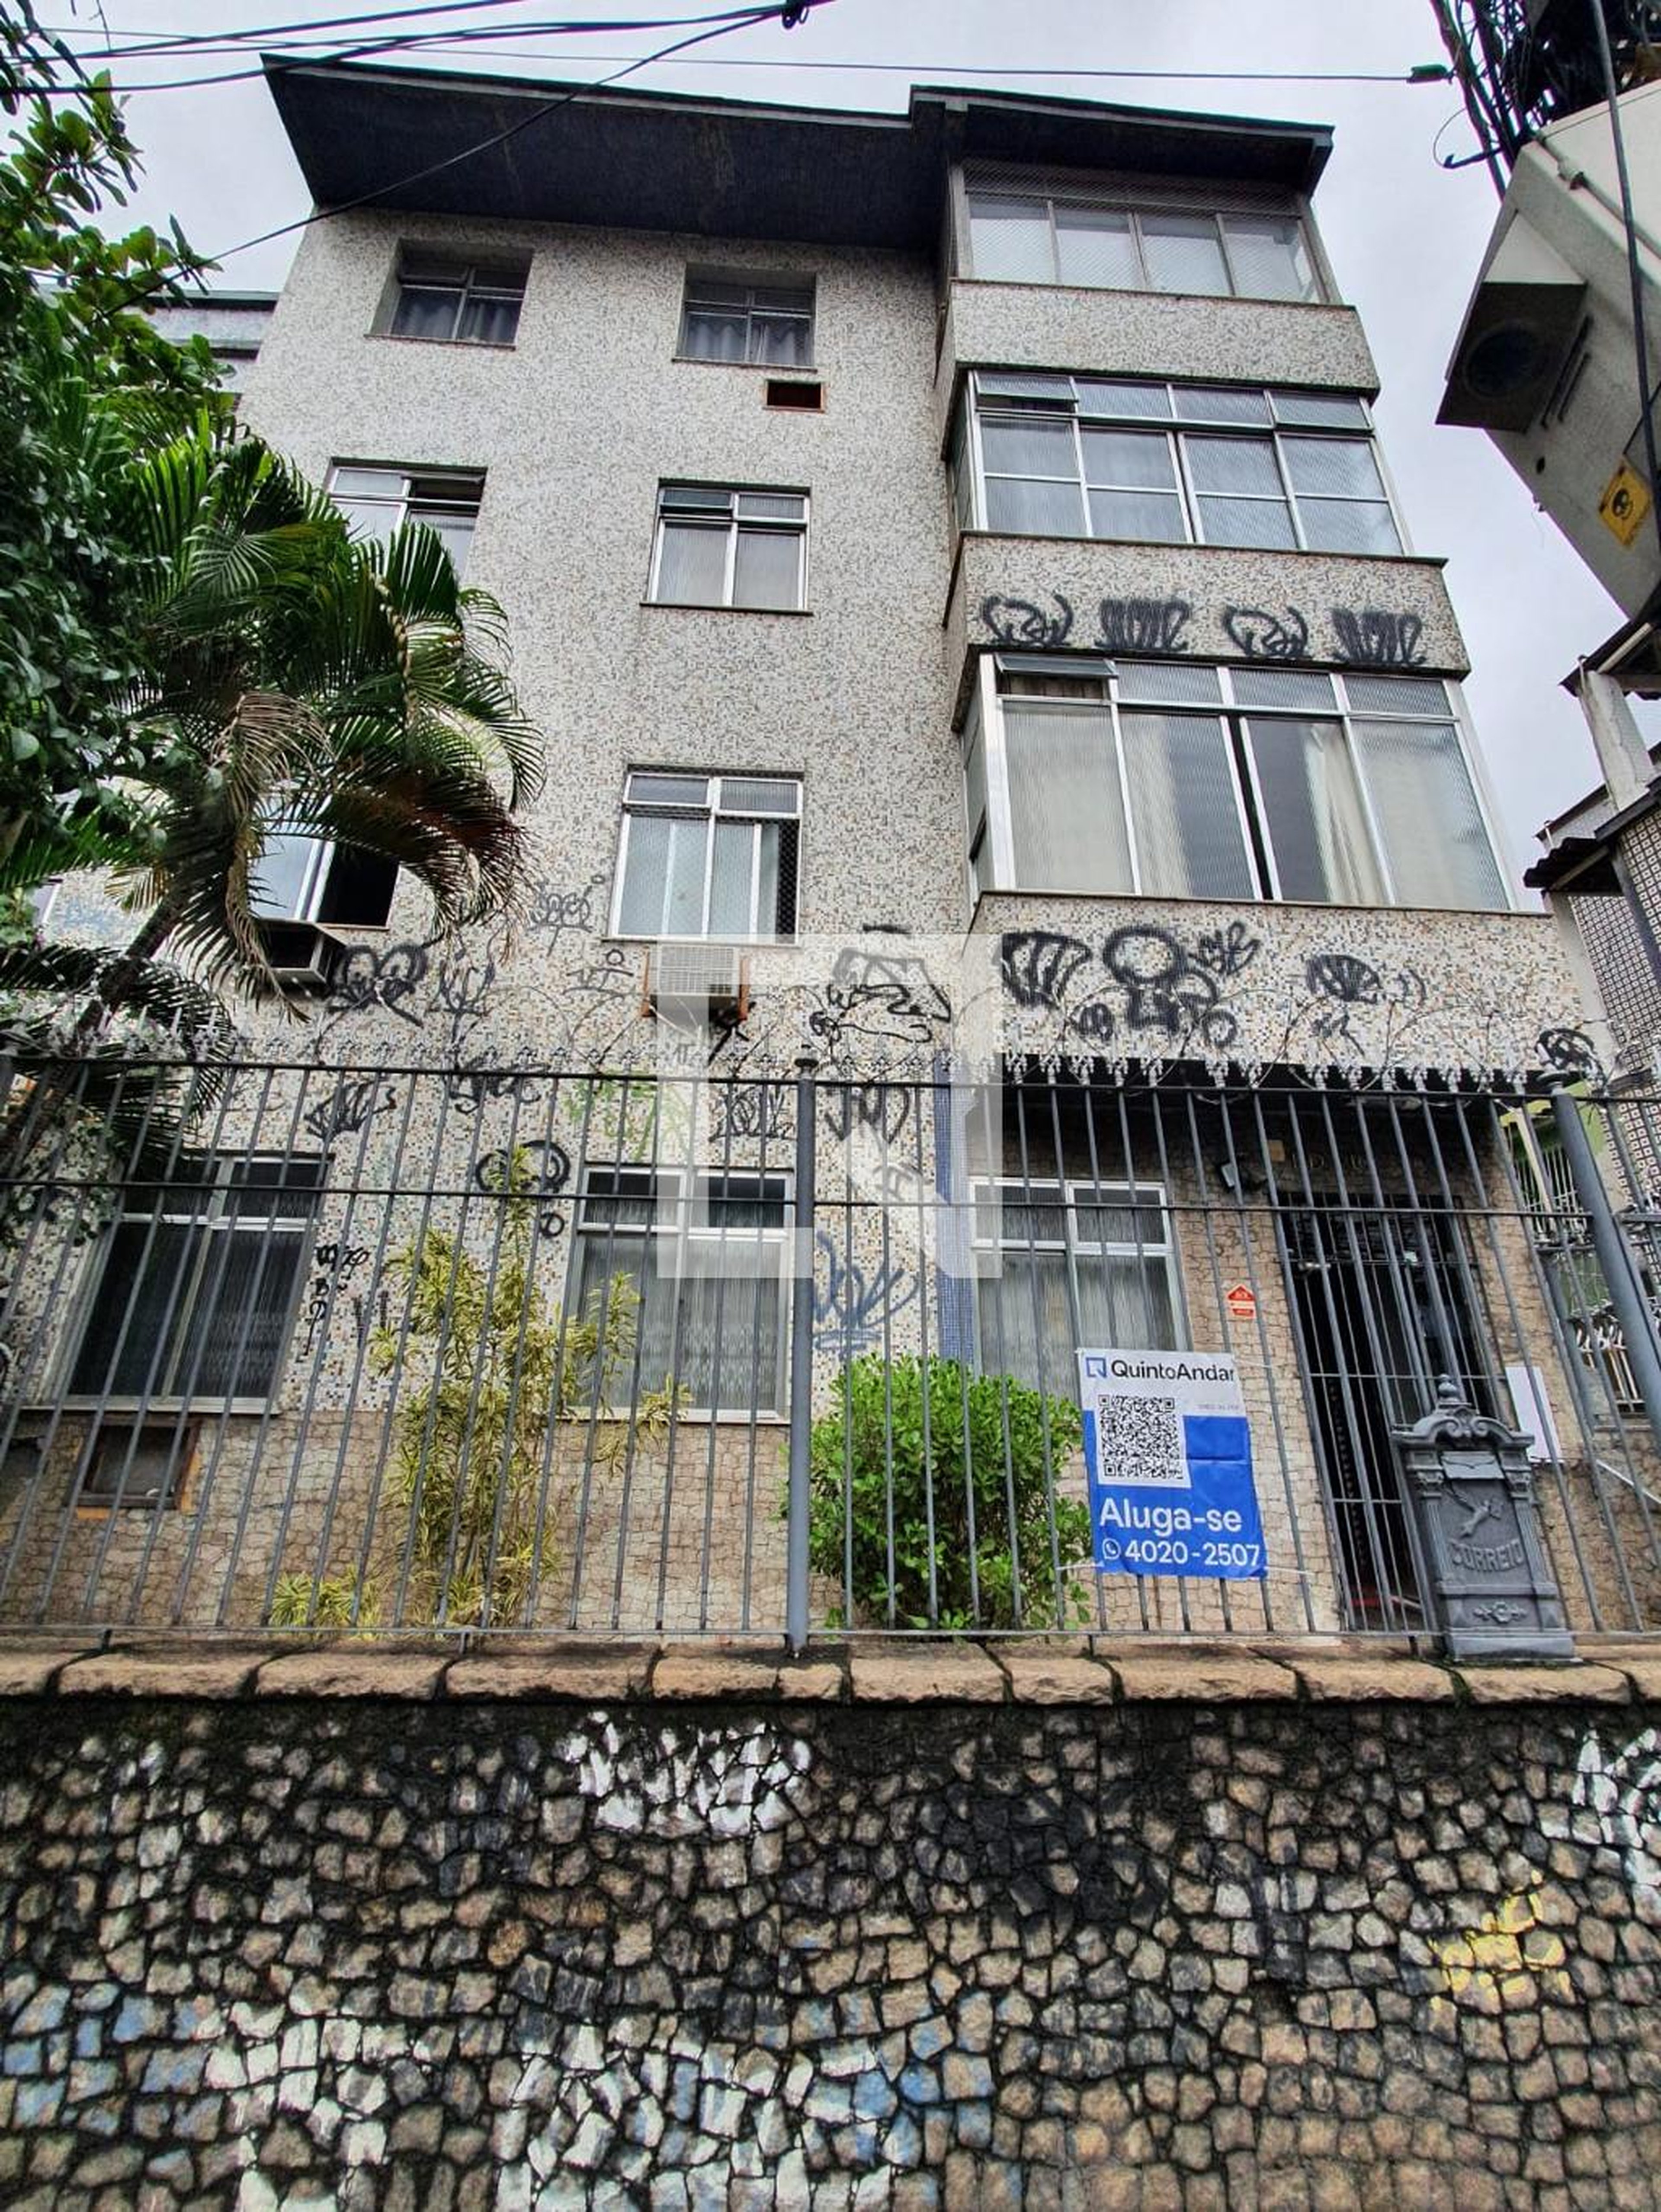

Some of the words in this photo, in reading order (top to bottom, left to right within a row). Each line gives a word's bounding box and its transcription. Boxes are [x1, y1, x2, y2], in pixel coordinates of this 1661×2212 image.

[1099, 1497, 1243, 1537] Aluga-se
[1125, 1540, 1260, 1567] 4020-2507
[1449, 1537, 1526, 1572] CORREIO
